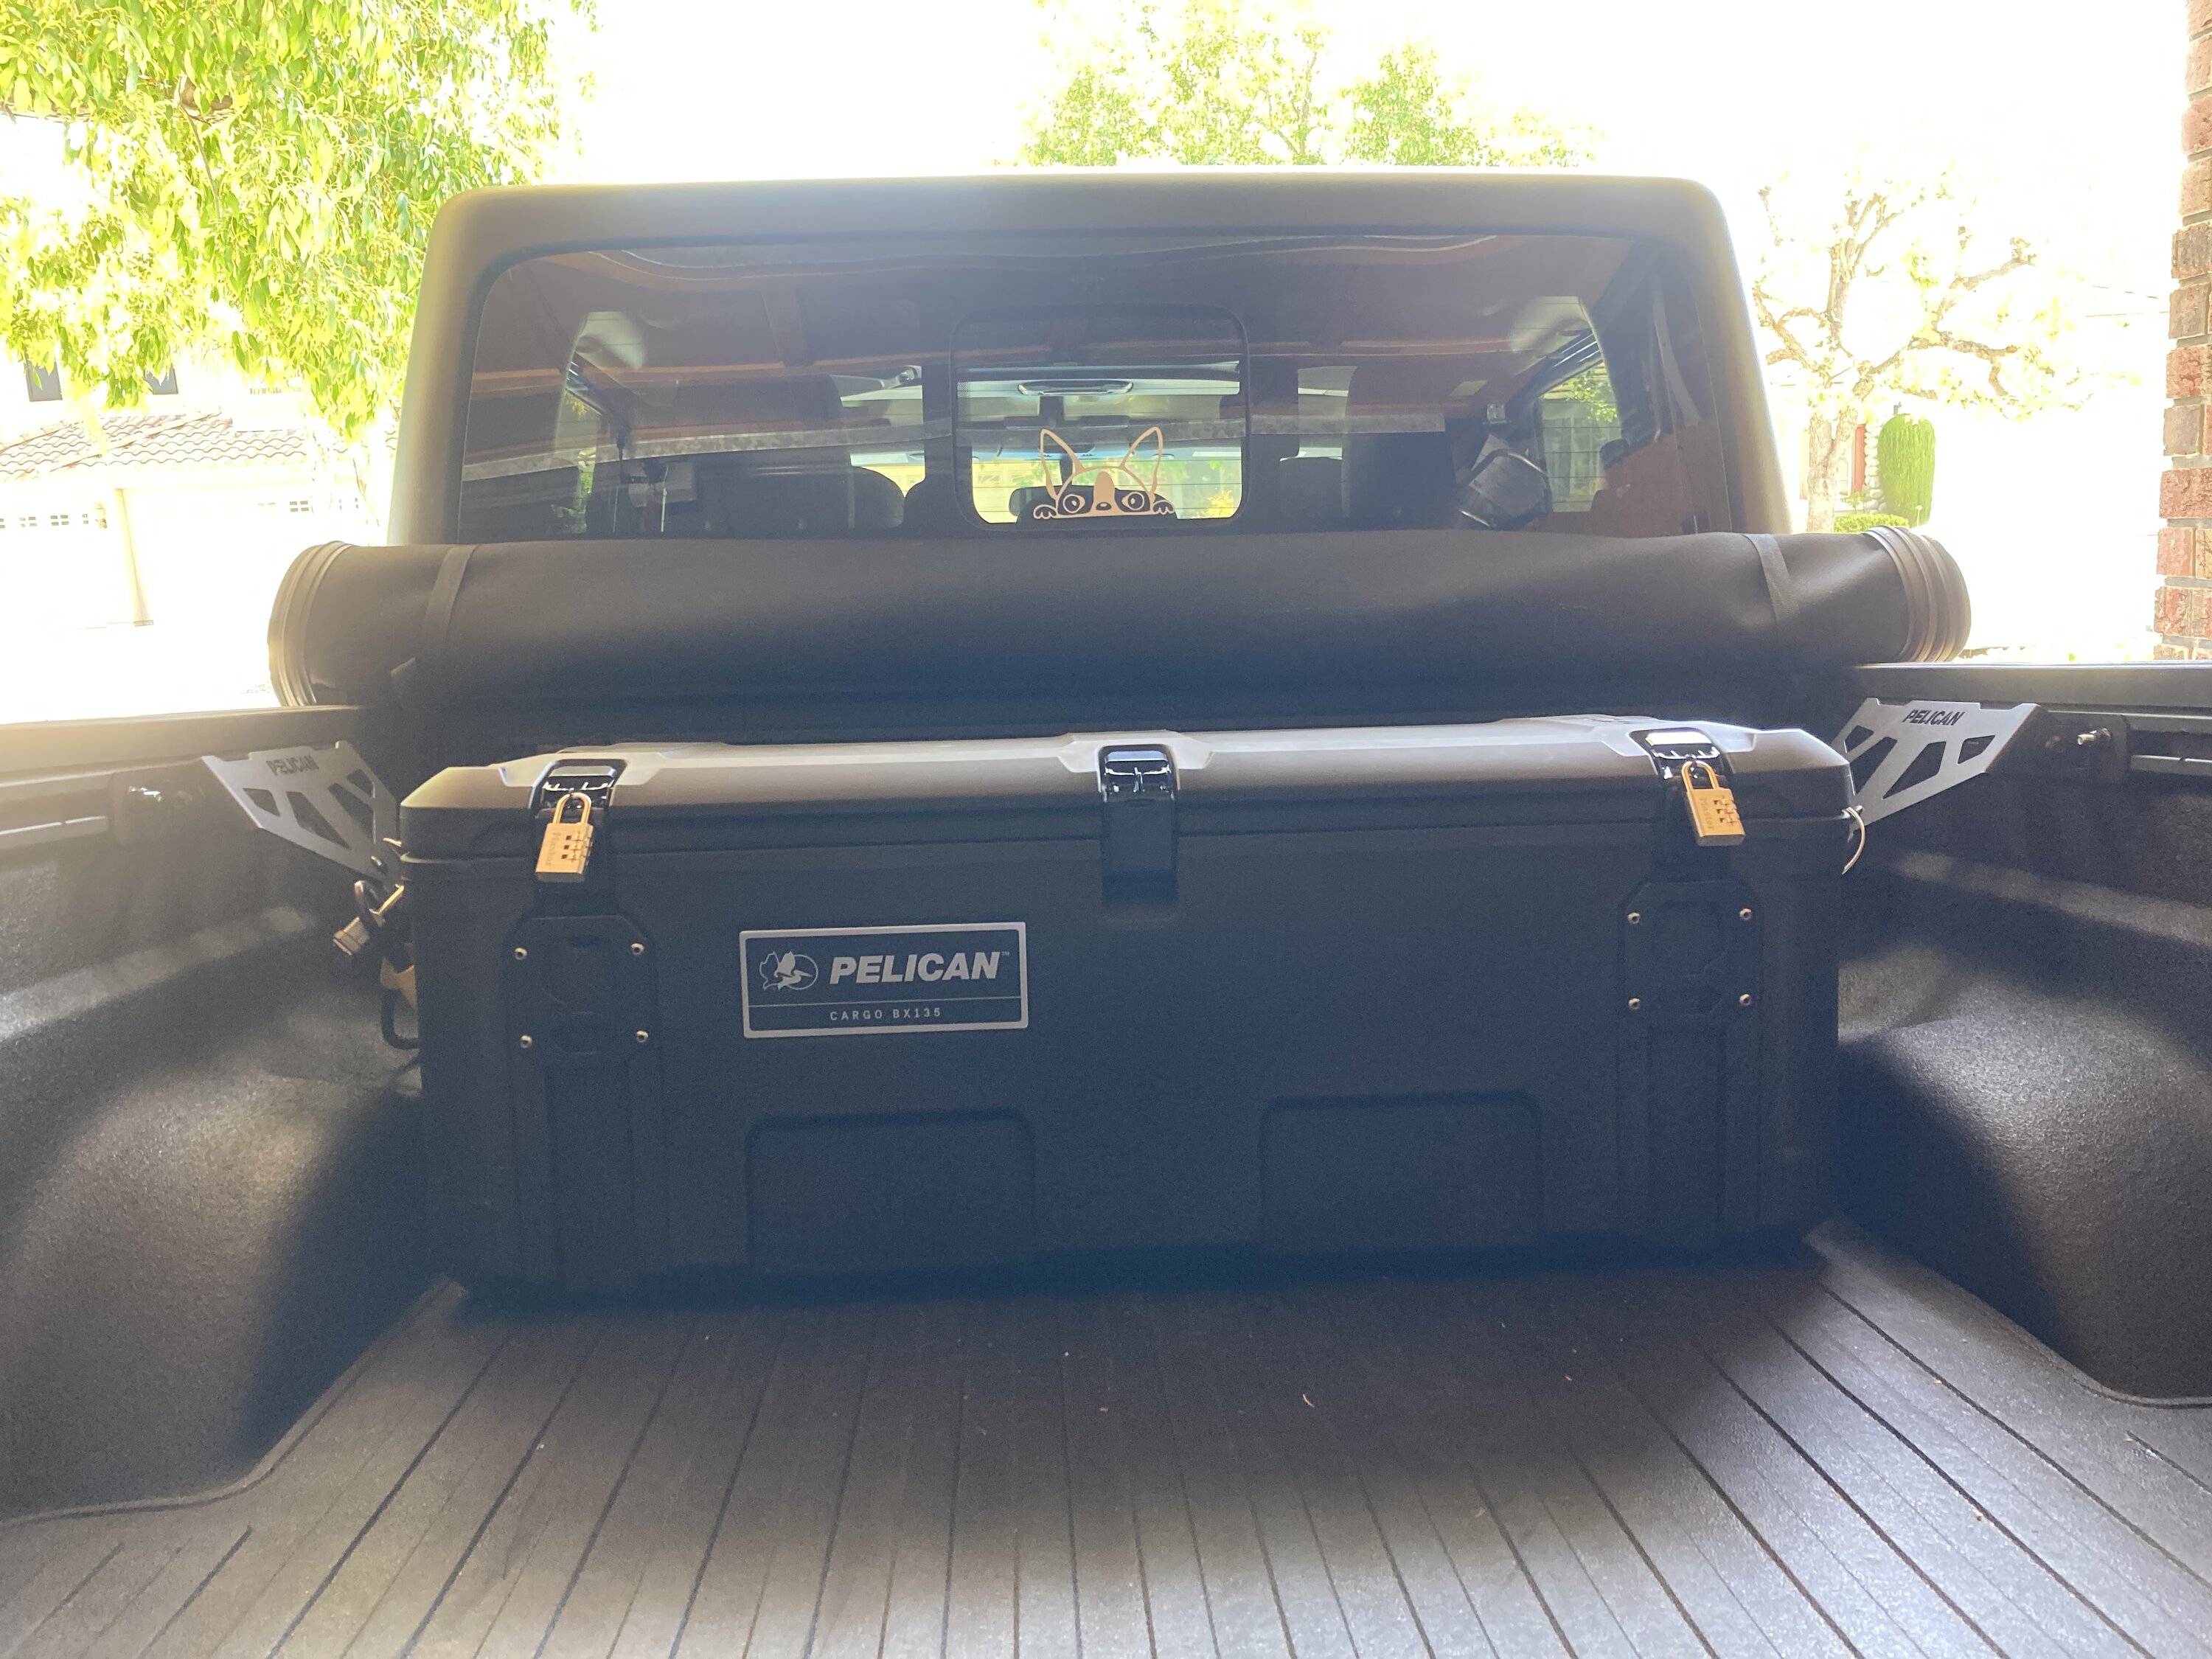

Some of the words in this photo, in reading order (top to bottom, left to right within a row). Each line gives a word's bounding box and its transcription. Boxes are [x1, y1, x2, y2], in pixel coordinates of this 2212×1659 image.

[1902, 709, 1966, 726] PELICAN
[266, 754, 320, 776] PELICAN
[830, 951, 1000, 985] PELICAN
[829, 1009, 883, 1021] CARGO
[892, 1007, 942, 1020] BX135
